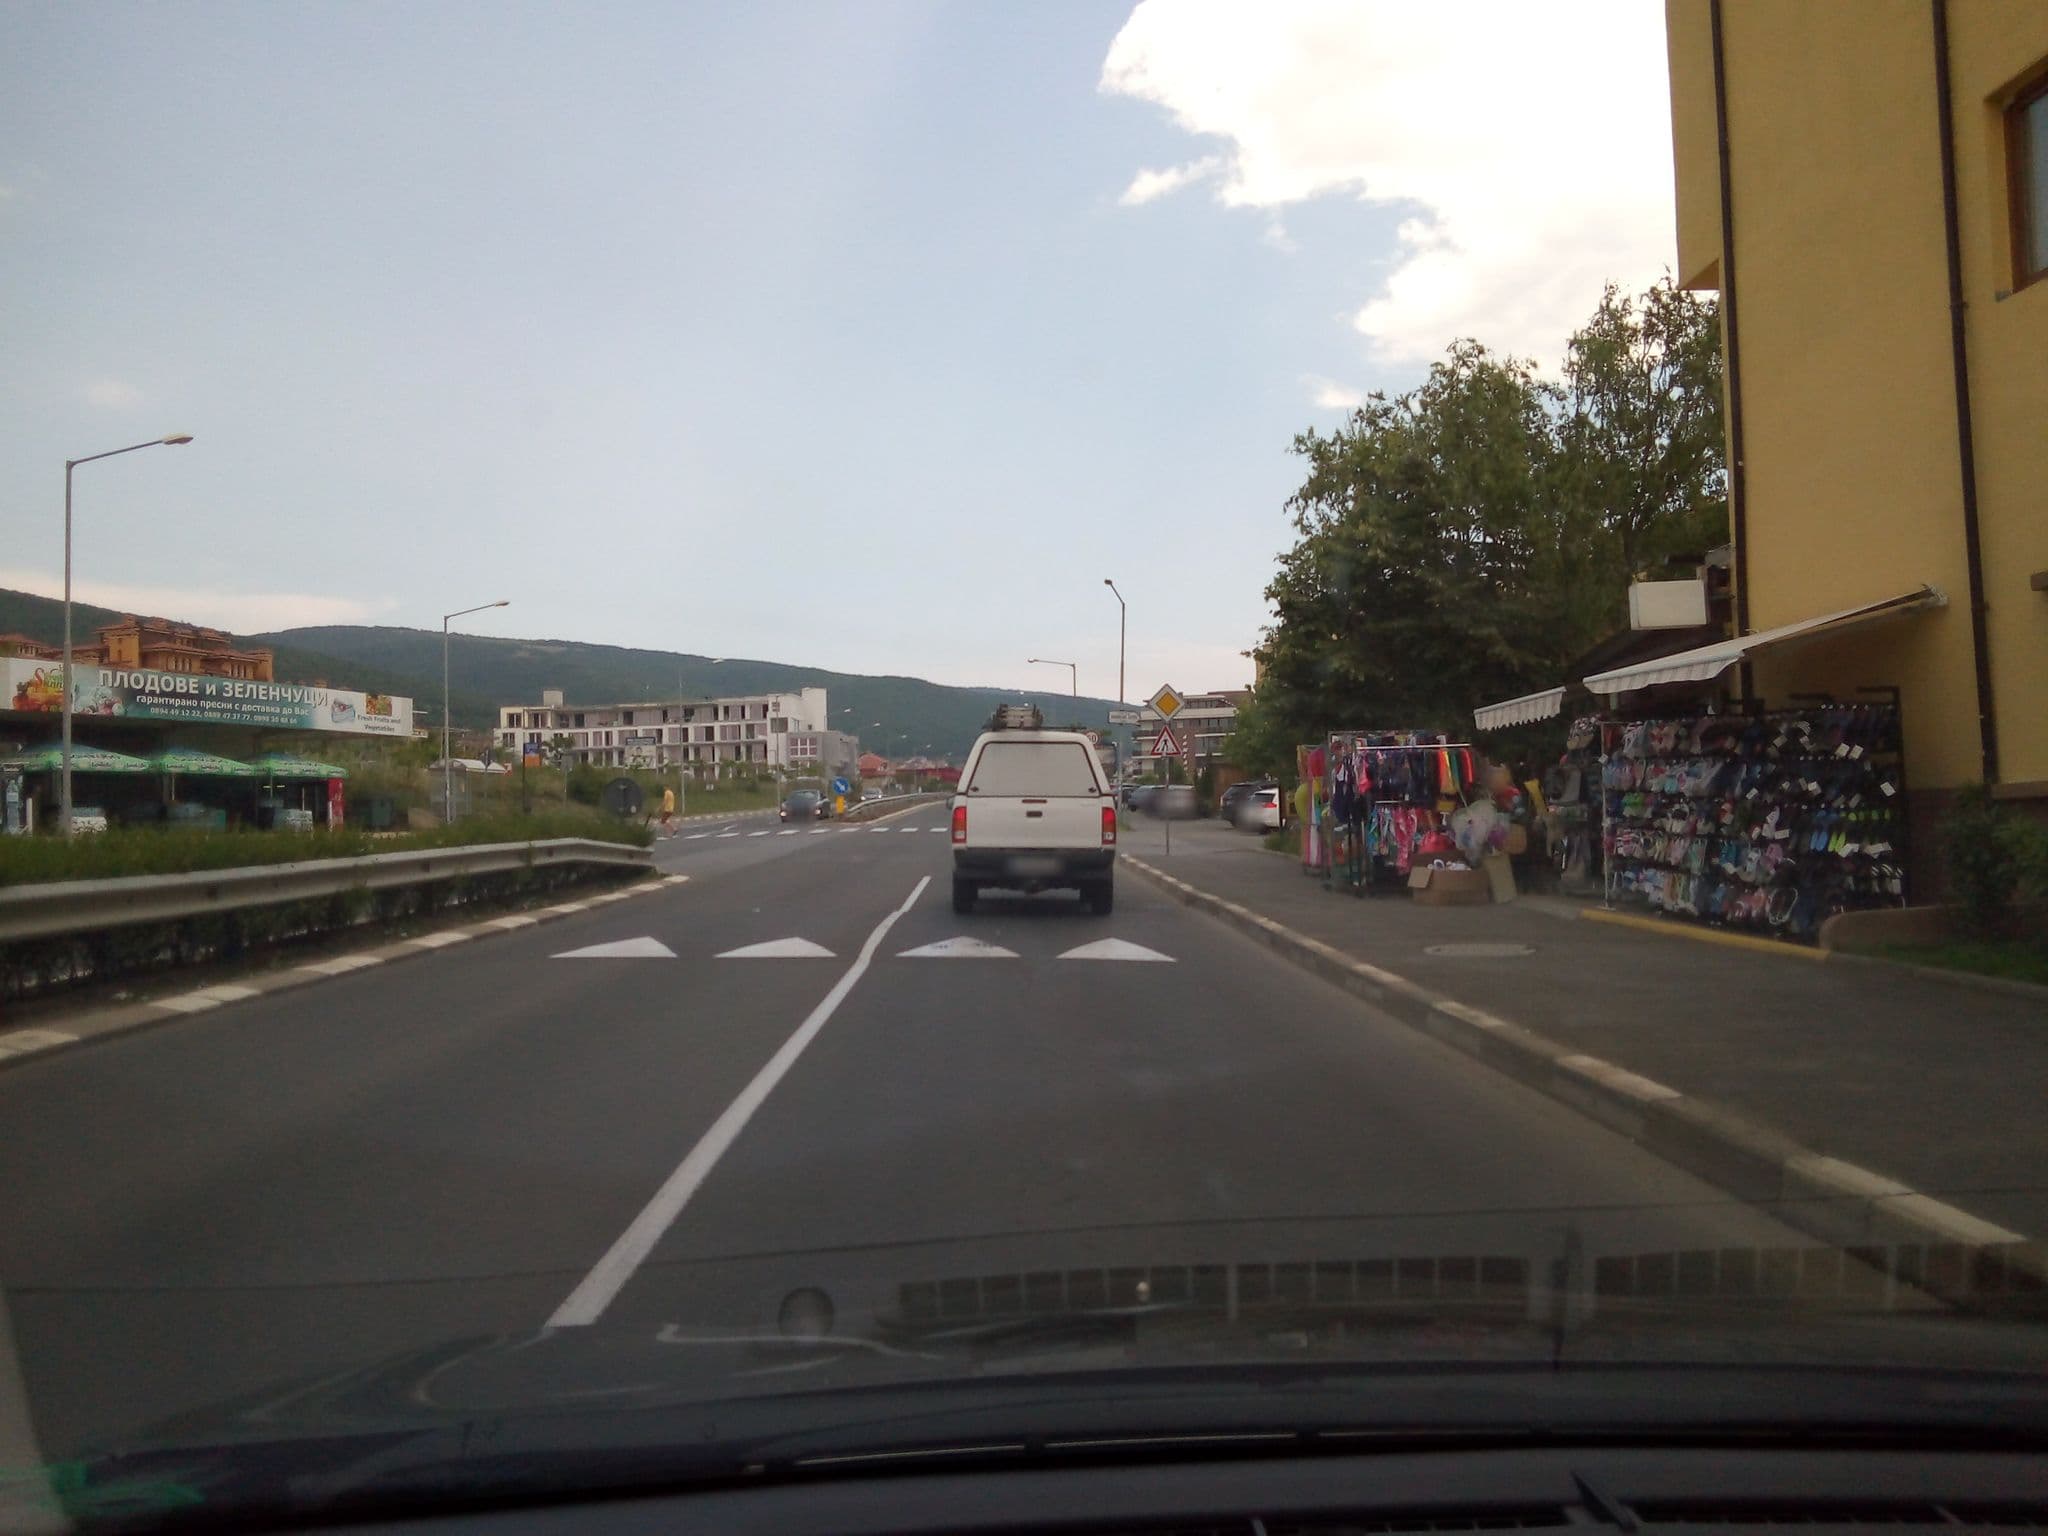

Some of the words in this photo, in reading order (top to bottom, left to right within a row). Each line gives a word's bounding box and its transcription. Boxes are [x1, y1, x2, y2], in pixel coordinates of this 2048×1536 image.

[99, 670, 199, 694] ПЛОДОВЕ
[205, 683, 217, 695] и
[222, 682, 328, 708] ЗЕЛЕНЧУЩИ
[136, 695, 198, 707] гарантирано
[200, 700, 233, 710] пресни
[241, 703, 280, 713] доставка
